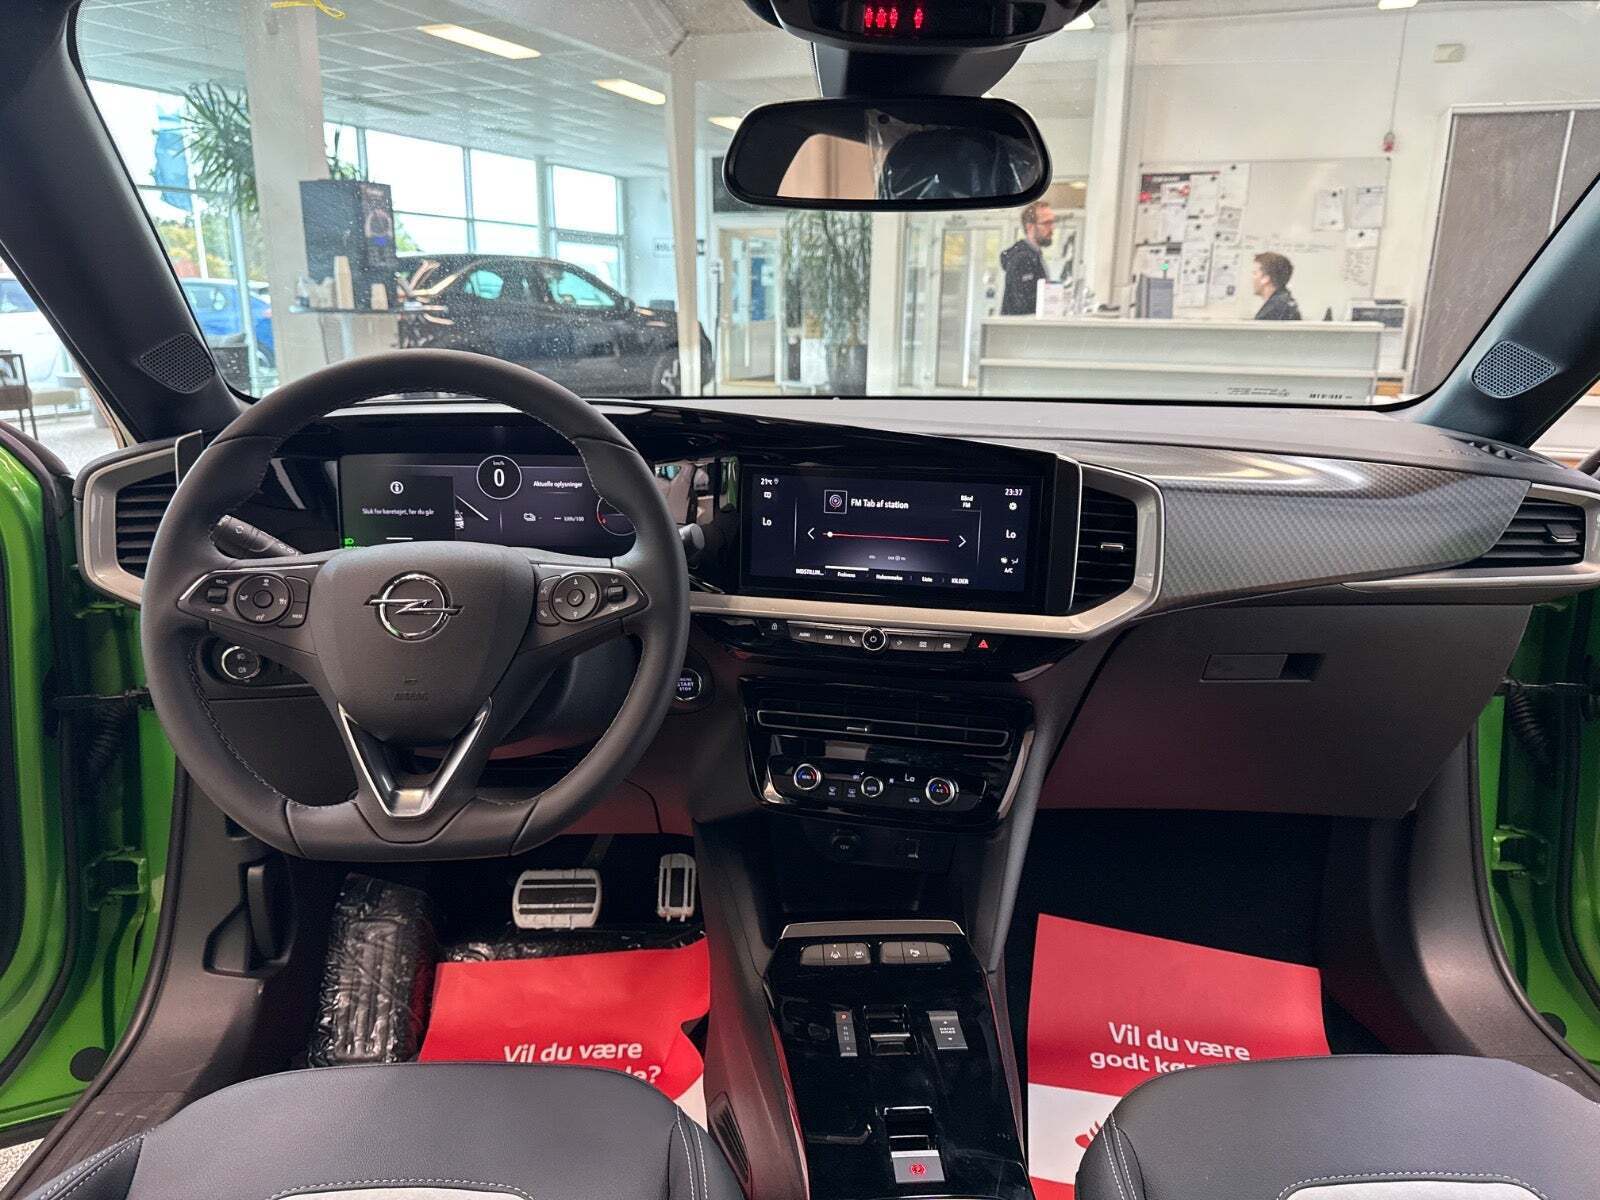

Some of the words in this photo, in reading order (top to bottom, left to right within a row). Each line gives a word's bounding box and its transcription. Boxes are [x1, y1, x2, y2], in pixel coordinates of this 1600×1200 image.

[493, 468, 505, 488] 0
[533, 480, 553, 488] Aktuelle
[554, 481, 583, 489] oplysninger
[1004, 488, 1023, 497] 23:37
[850, 498, 862, 507] FM
[863, 499, 876, 508] Tab
[876, 500, 884, 508] af
[884, 501, 909, 510] station
[762, 516, 773, 527] Lo
[1005, 529, 1017, 539] Lo
[1108, 1021, 1141, 1047] Vil
[1146, 1029, 1179, 1052] du
[1183, 1039, 1251, 1061] være
[503, 1044, 536, 1063] Vil
[540, 1042, 573, 1062] du
[578, 1042, 643, 1060] være
[1090, 1051, 1150, 1071] godt
